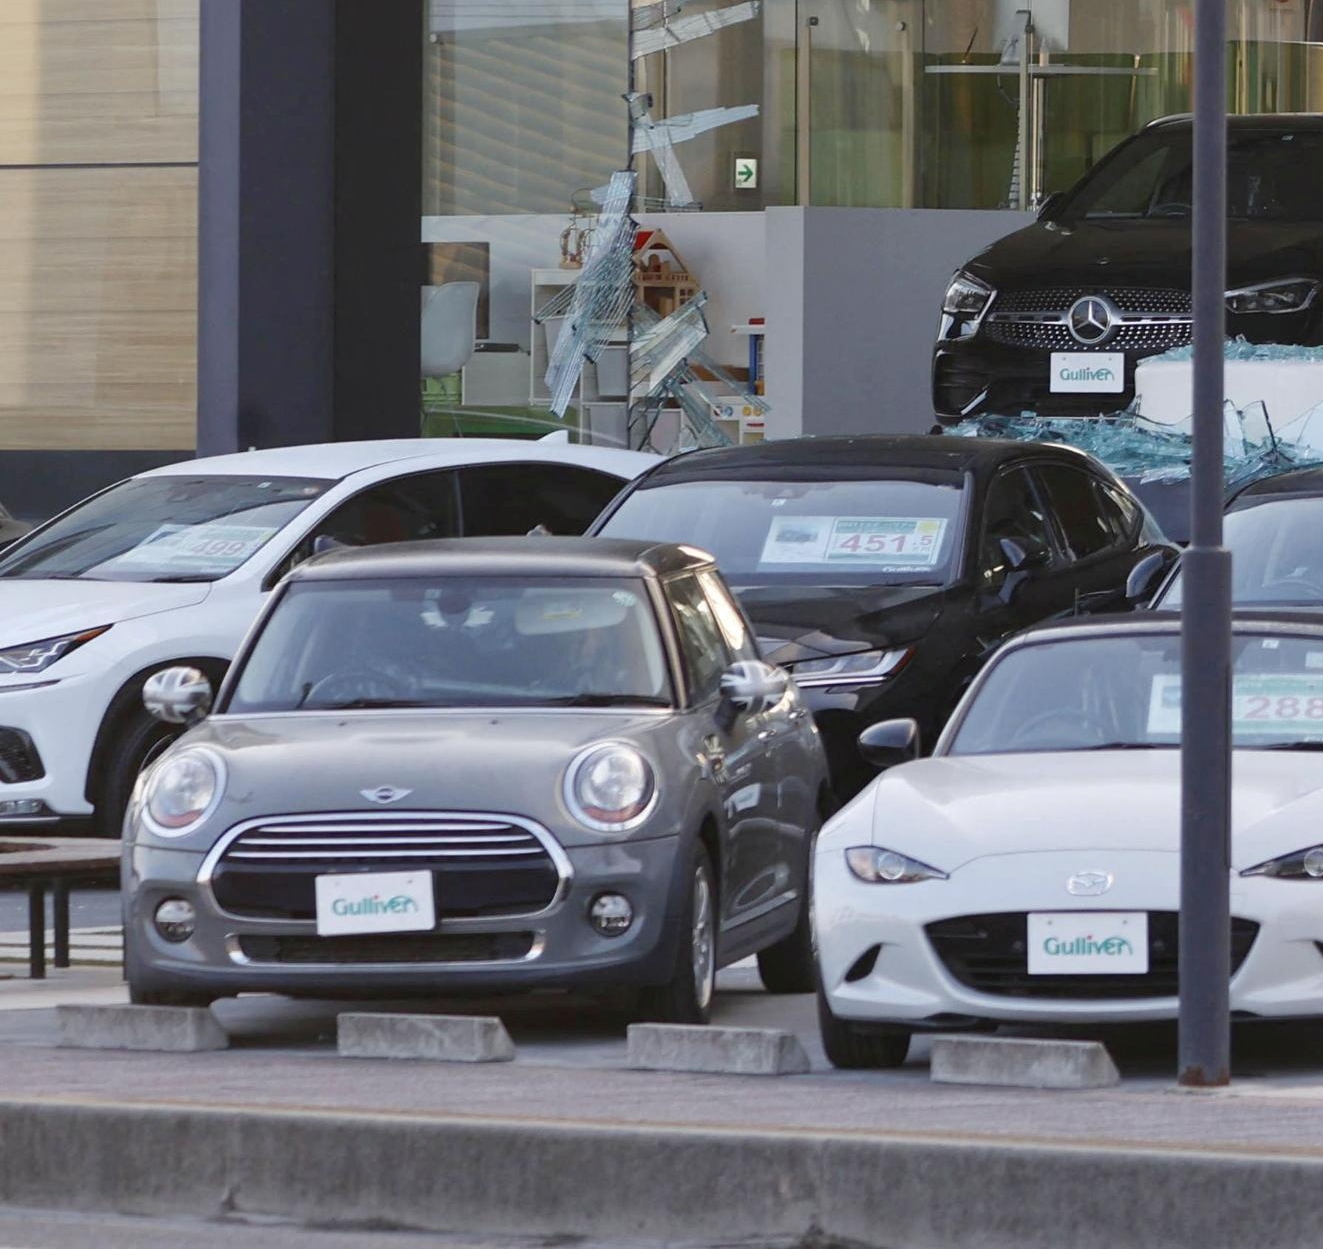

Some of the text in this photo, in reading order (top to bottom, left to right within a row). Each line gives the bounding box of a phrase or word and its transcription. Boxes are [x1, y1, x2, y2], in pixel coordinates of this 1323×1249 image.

[1059, 367, 1115, 381] Gulliver
[332, 894, 418, 917] Gulliver
[1043, 935, 1134, 956] Gulliver
